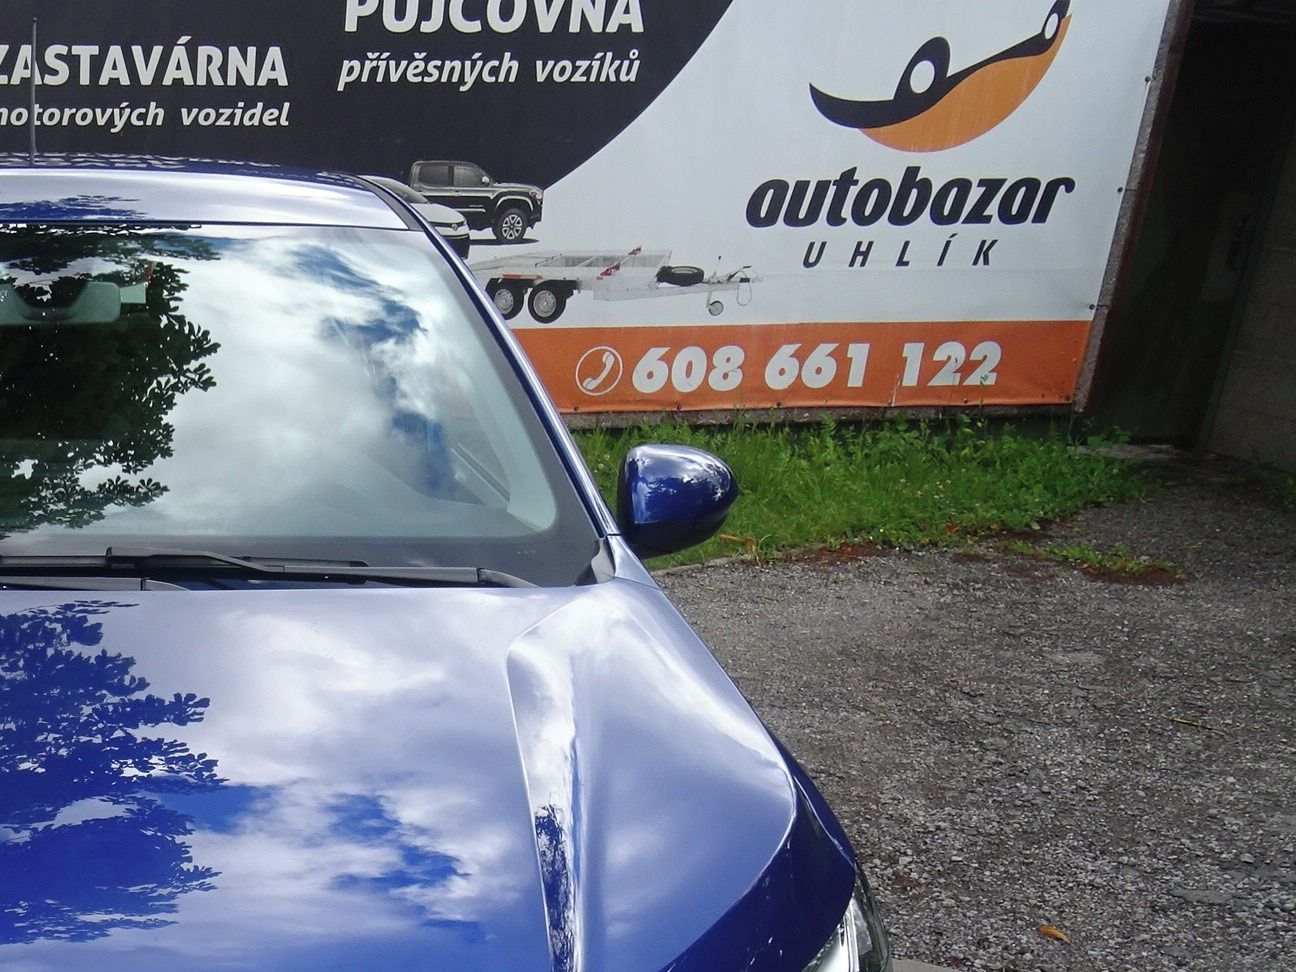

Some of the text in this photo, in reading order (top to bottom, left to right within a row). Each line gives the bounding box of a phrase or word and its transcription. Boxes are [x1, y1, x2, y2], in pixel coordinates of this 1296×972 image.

[337, 49, 641, 92] přívěsných vozíků
[181, 101, 290, 127] vozidel
[745, 166, 1076, 228] autobazar
[802, 233, 999, 269] UHLÍK
[631, 340, 1003, 394] 608 661 122
